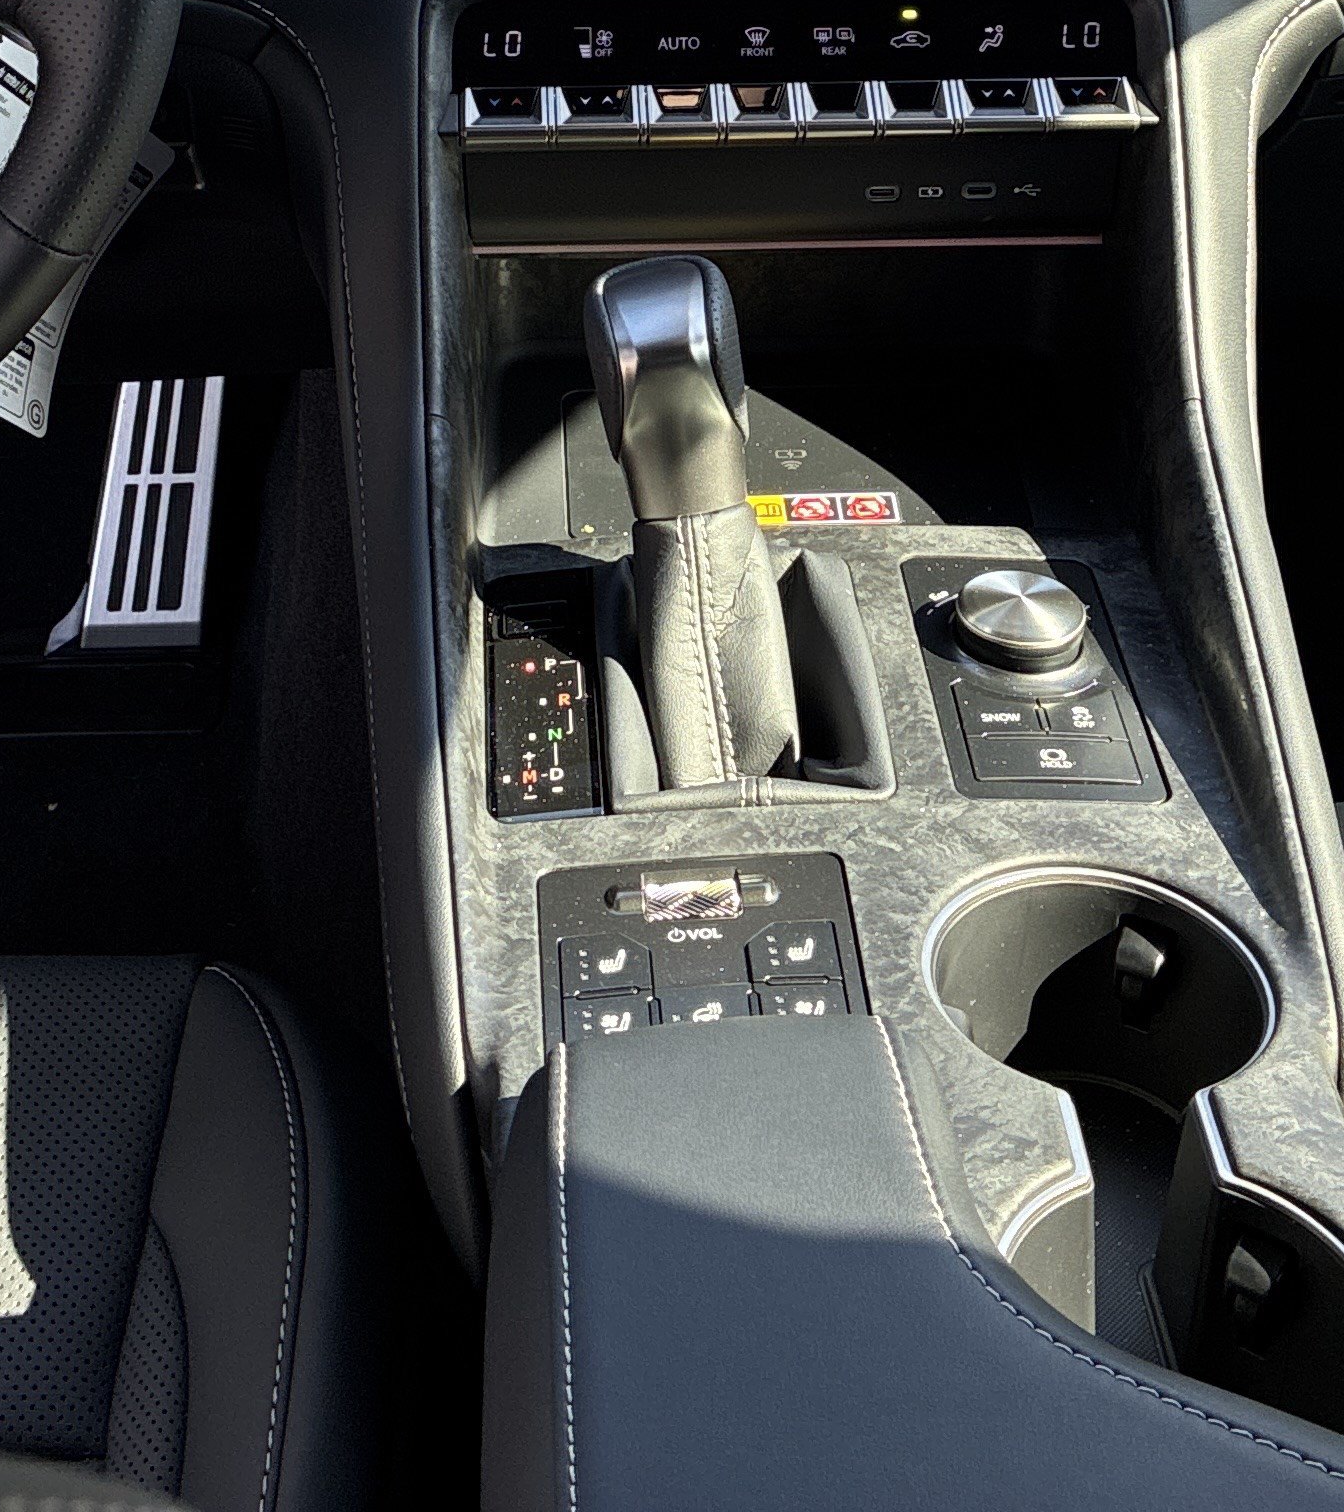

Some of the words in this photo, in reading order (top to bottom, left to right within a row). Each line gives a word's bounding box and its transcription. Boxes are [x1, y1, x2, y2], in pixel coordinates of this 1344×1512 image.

[657, 36, 701, 51] AUTO
[594, 47, 614, 58] OFF
[740, 47, 775, 57] FRONT
[821, 46, 847, 56] REAR
[30, 403, 44, 425] G
[544, 657, 557, 672] P
[558, 693, 572, 707] R
[980, 711, 1021, 723] SNOW
[1073, 719, 1096, 729] OFF
[547, 727, 563, 741] N
[1039, 759, 1073, 769] HOLD
[522, 769, 538, 785] M
[549, 766, 565, 781] D
[686, 927, 724, 941] VOL
